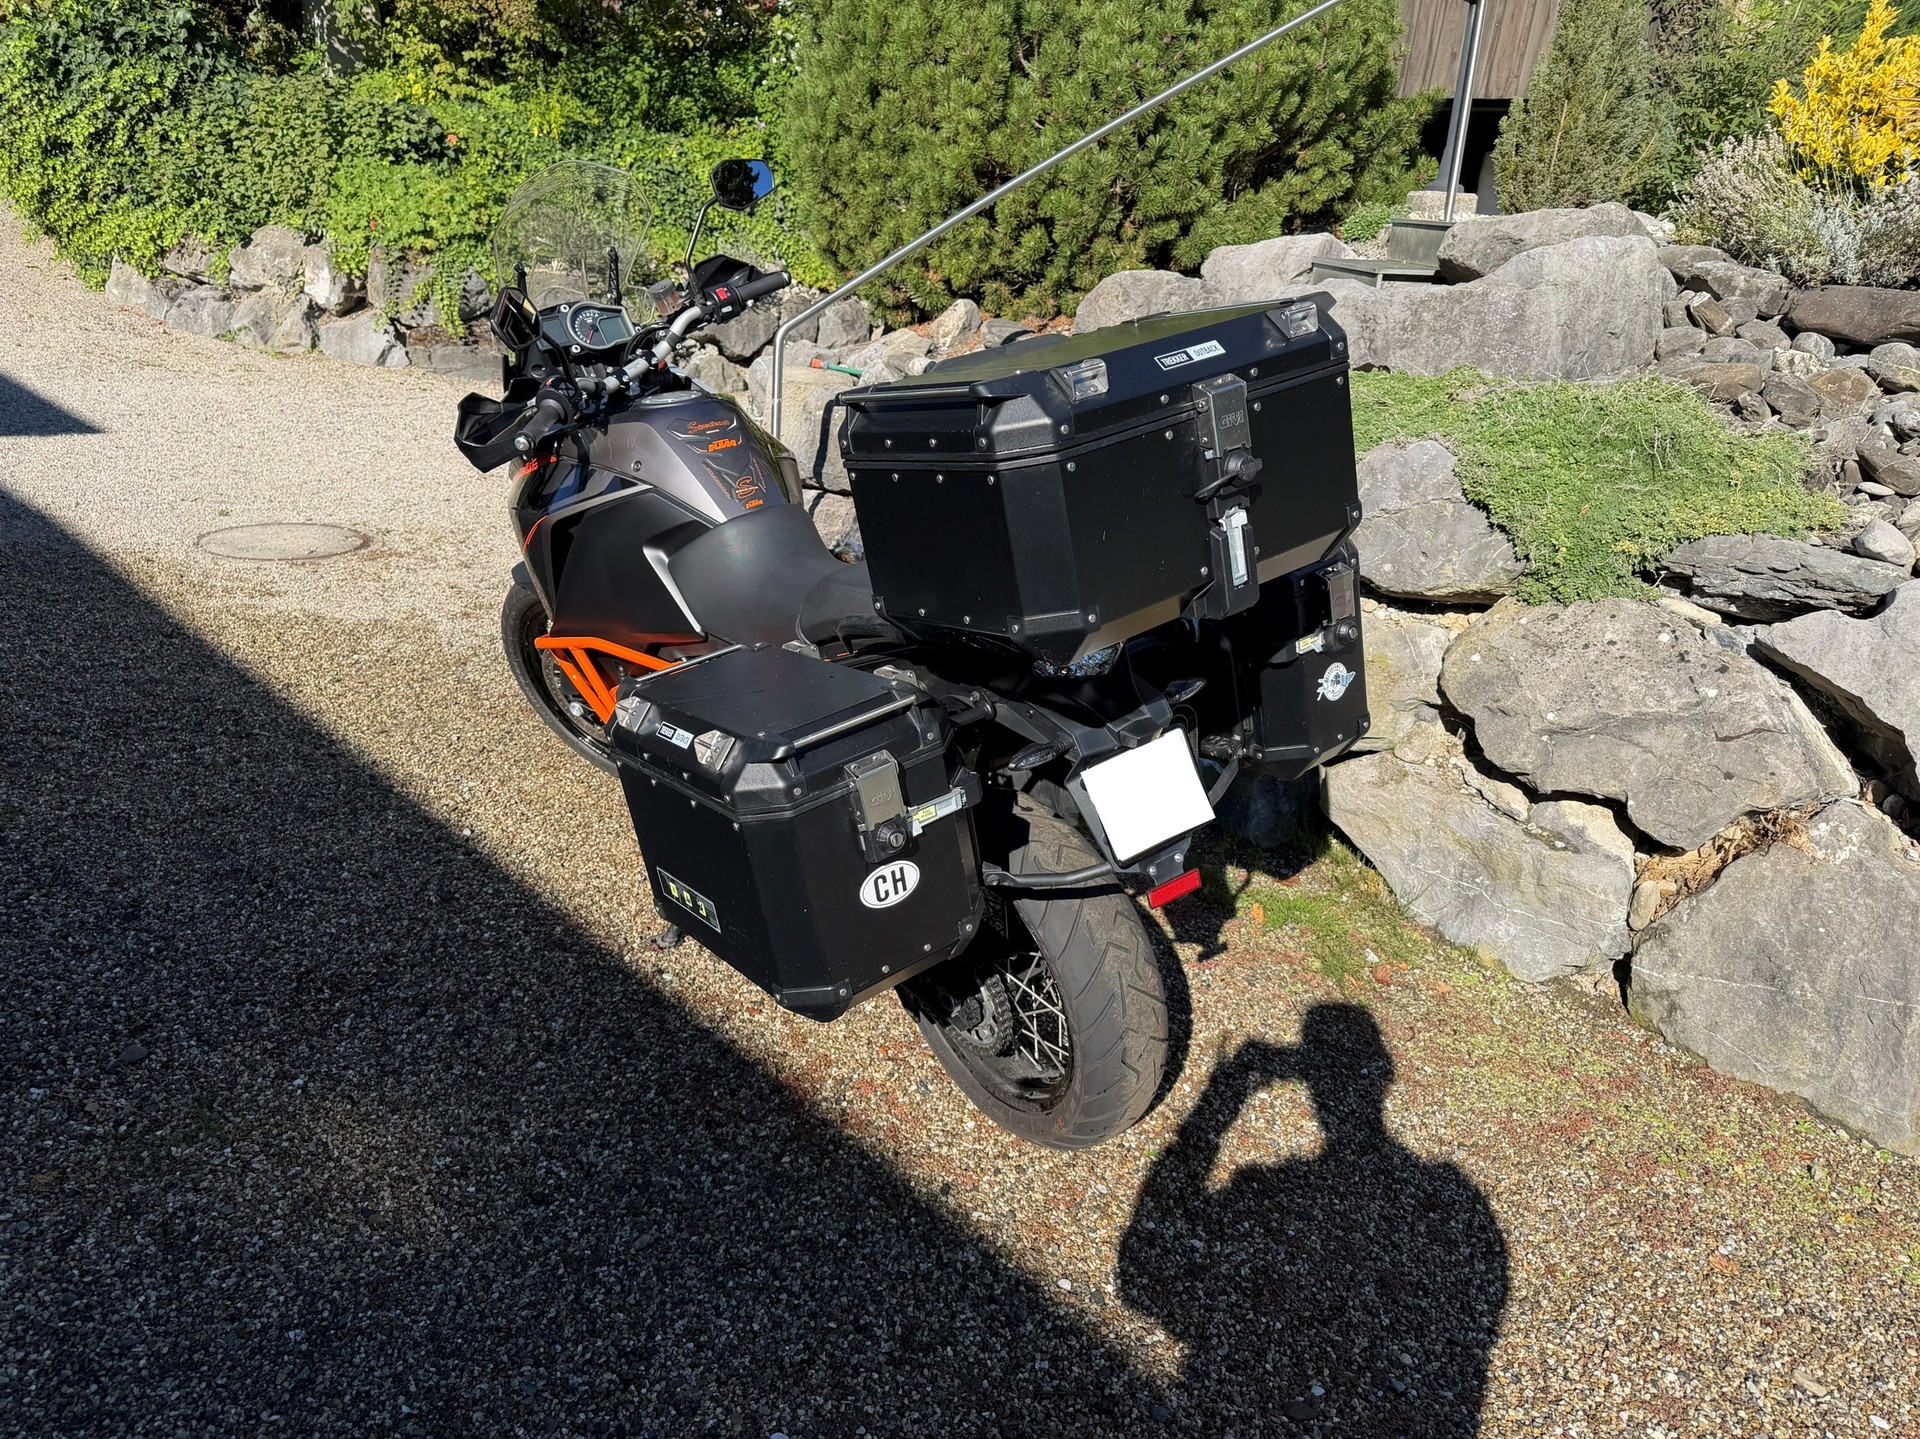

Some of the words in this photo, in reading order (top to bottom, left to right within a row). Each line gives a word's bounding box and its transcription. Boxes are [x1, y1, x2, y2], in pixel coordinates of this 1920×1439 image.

[1160, 353, 1190, 367] TREKKER
[1193, 344, 1220, 357] OUTBACK
[1219, 409, 1245, 429] GIVI
[707, 438, 738, 453] KTM
[745, 499, 764, 509] KTM
[873, 866, 908, 903] CH
